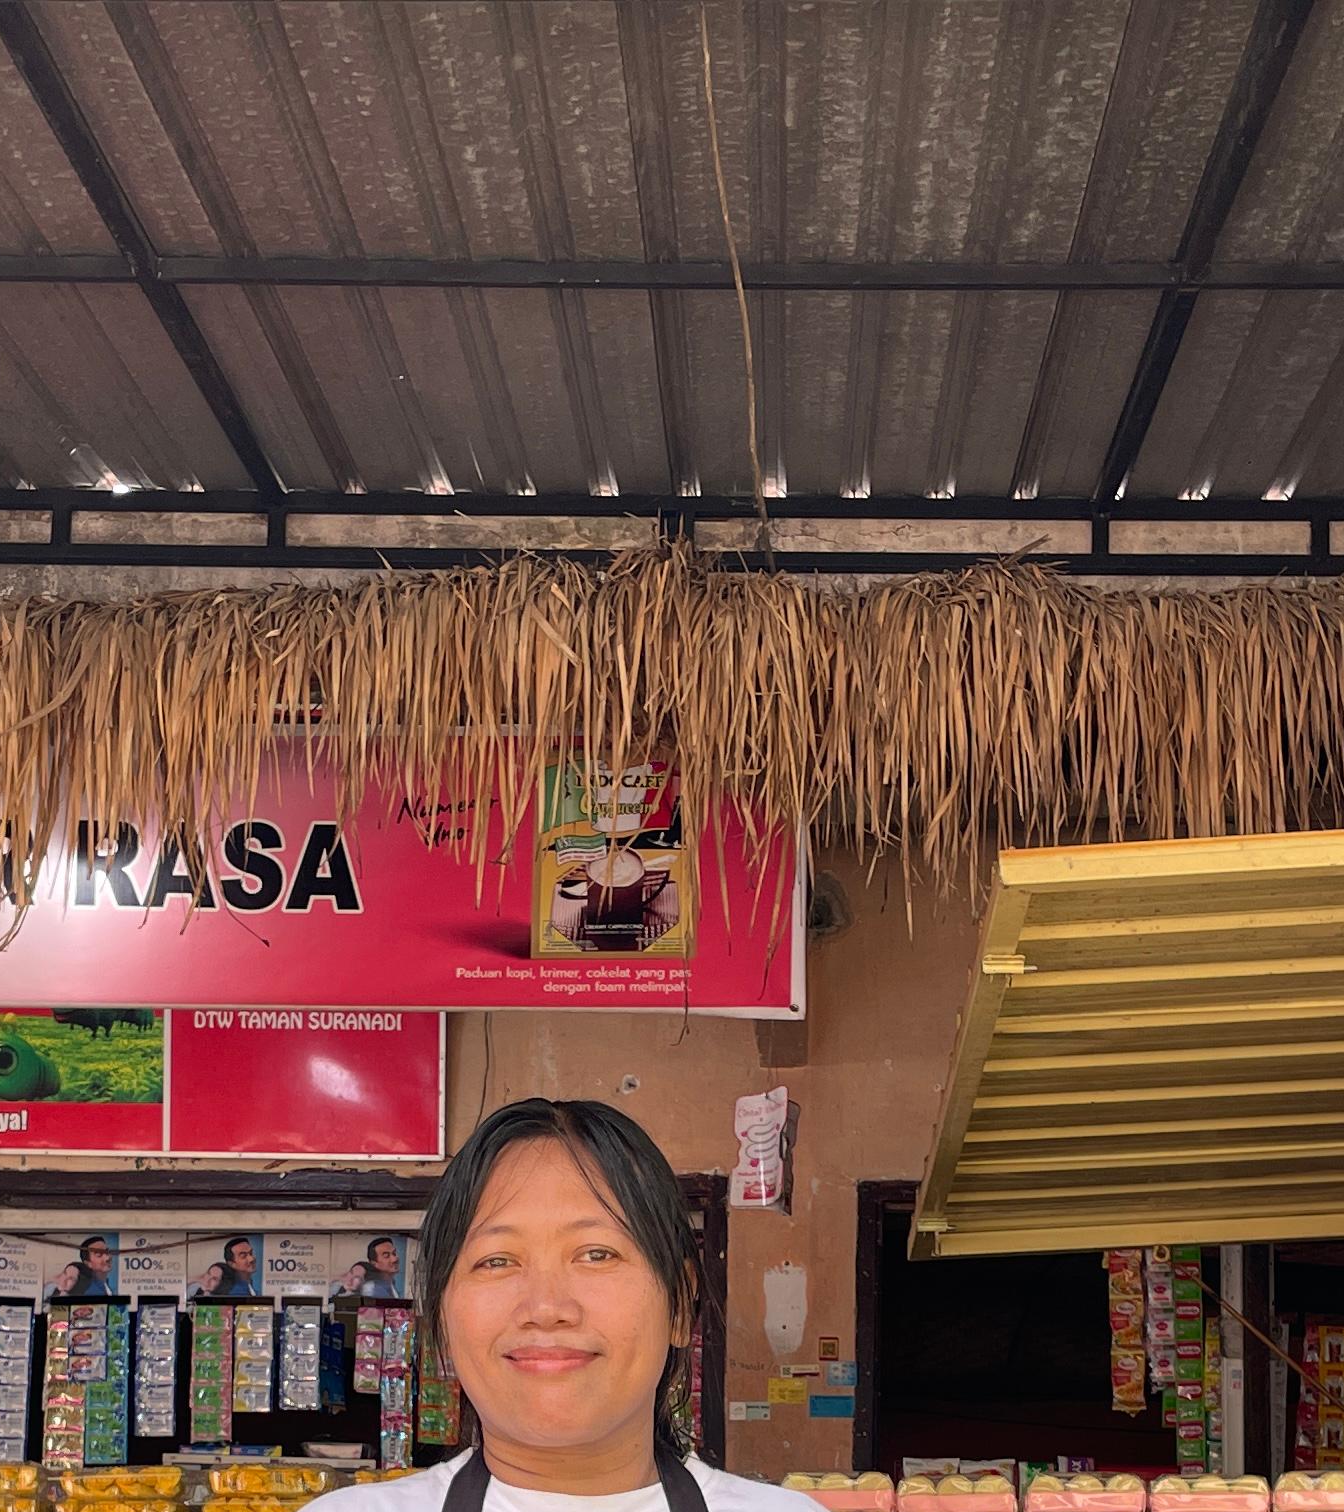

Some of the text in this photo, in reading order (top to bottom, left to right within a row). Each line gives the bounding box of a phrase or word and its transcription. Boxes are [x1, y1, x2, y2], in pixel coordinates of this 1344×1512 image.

[76, 818, 360, 910] RASA
[456, 966, 692, 982] Paduan kopi, krimer, cokelat yang pas
[543, 982, 591, 994] dengan
[594, 981, 625, 992] foam
[194, 1009, 402, 1031] DTW TAMAN SURANADI
[124, 1256, 164, 1272] 100%
[267, 1258, 308, 1273] 100%
